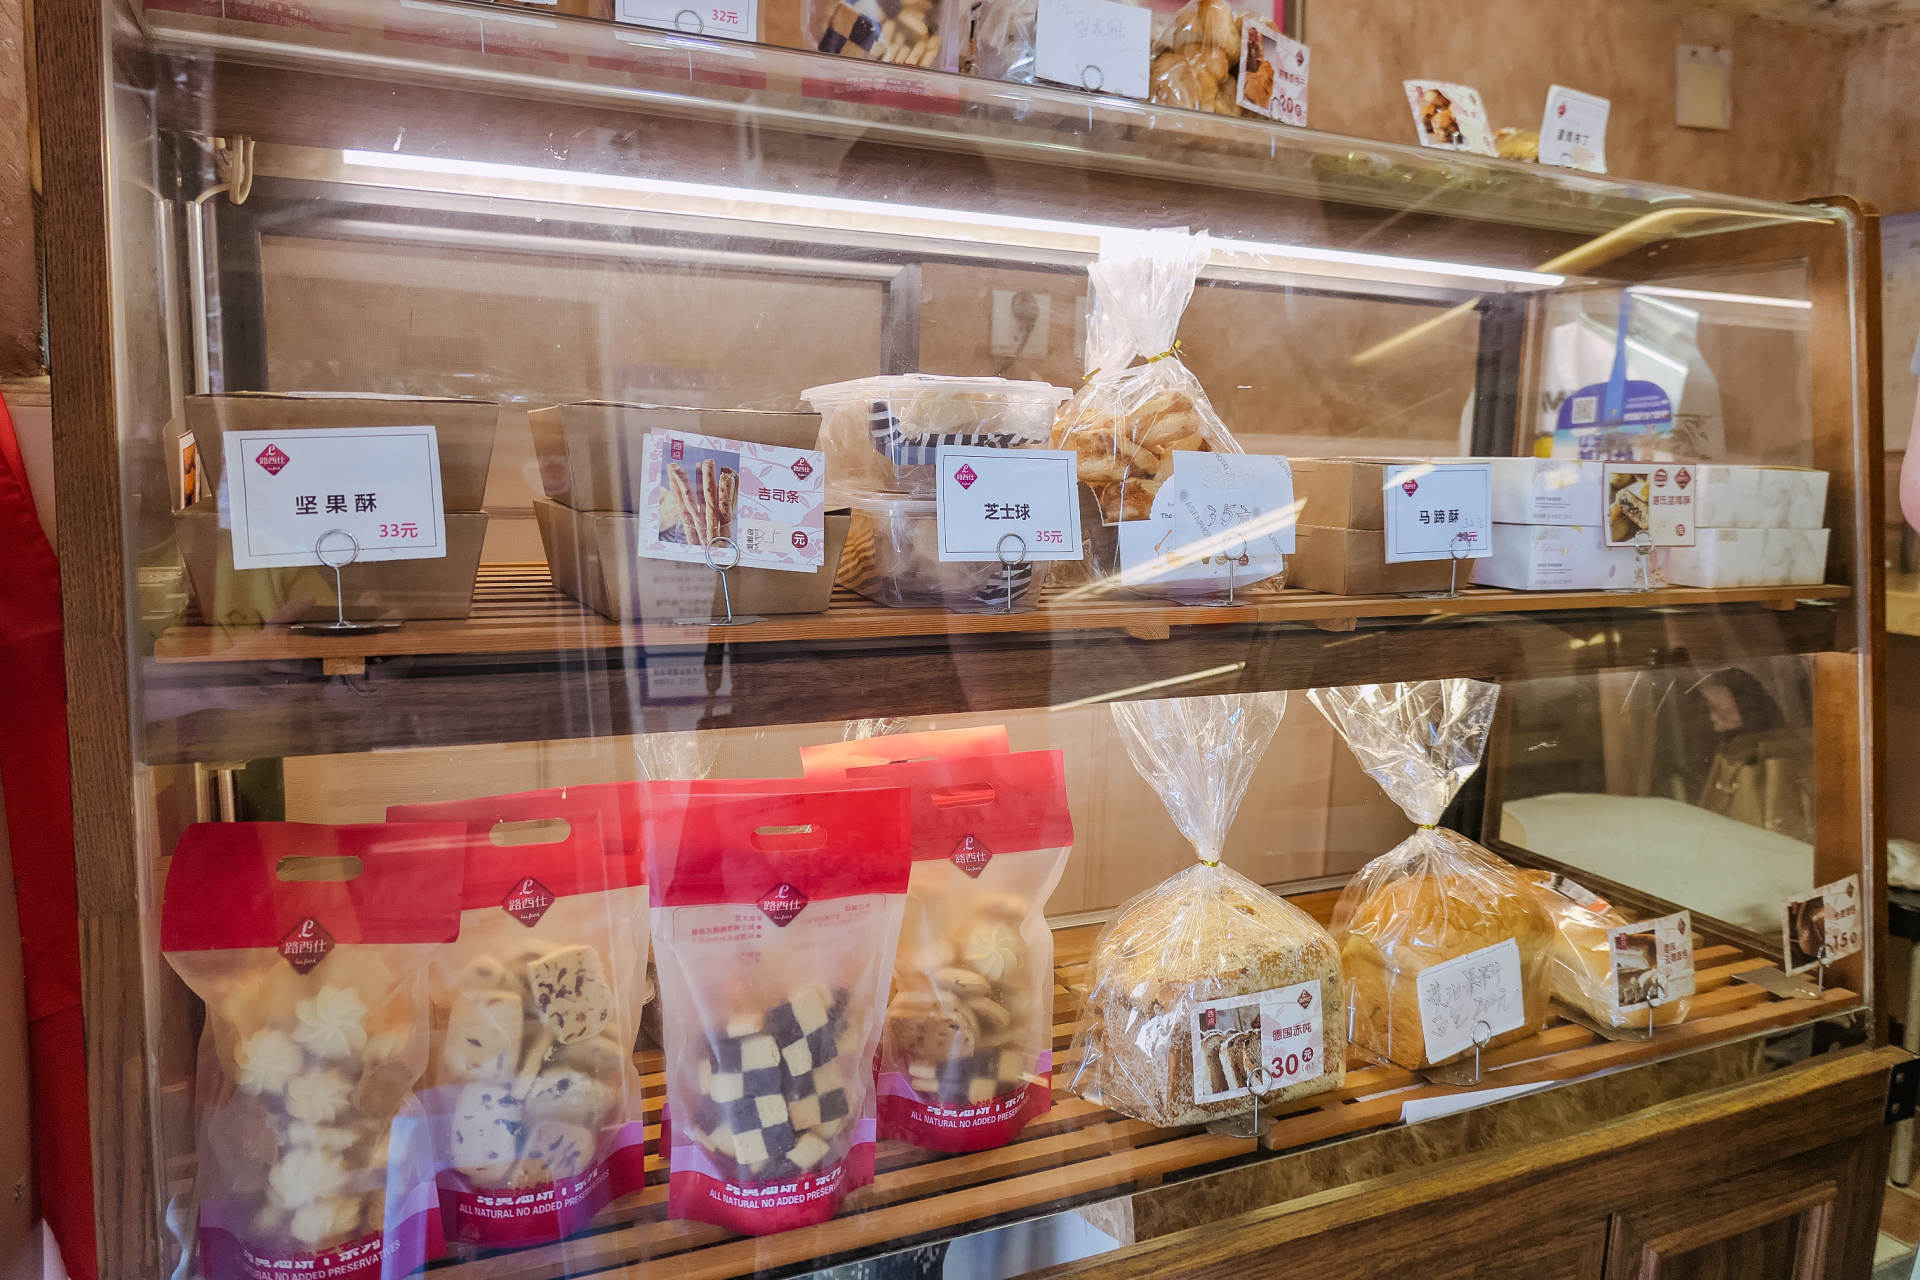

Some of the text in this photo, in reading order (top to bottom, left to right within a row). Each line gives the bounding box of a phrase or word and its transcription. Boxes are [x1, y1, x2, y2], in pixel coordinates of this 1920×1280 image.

[711, 9, 739, 25] 32元
[758, 487, 800, 504] 吉司条
[296, 493, 377, 515] 坚果酥
[984, 503, 1030, 520] 芝士球
[1418, 509, 1459, 525] 马蹄酥
[379, 522, 418, 538] 33元
[1035, 529, 1063, 543] 35元
[794, 533, 806, 545] 元
[954, 851, 987, 864] 路西仕
[508, 895, 549, 911] 路西仕
[763, 899, 802, 912] 路西仕
[284, 939, 328, 954] 路西仕
[1272, 1022, 1312, 1041] 德国赤吨
[1271, 1053, 1299, 1079] 30
[911, 1111, 922, 1121] ALL
[923, 1116, 958, 1128] NATURAL
[959, 1120, 971, 1128] NO
[972, 1115, 996, 1126] ADDED
[709, 1189, 722, 1201] ALL
[722, 1195, 760, 1209] NATURAL
[761, 1199, 775, 1208] NO
[776, 1194, 805, 1206] ADDED
[459, 1203, 474, 1215] ALL
[474, 1207, 514, 1218] NATURAL
[516, 1207, 531, 1216] NO
[532, 1200, 563, 1215] ADDED
[274, 1271, 289, 1280] NO
[292, 1270, 326, 1280] ADDED
